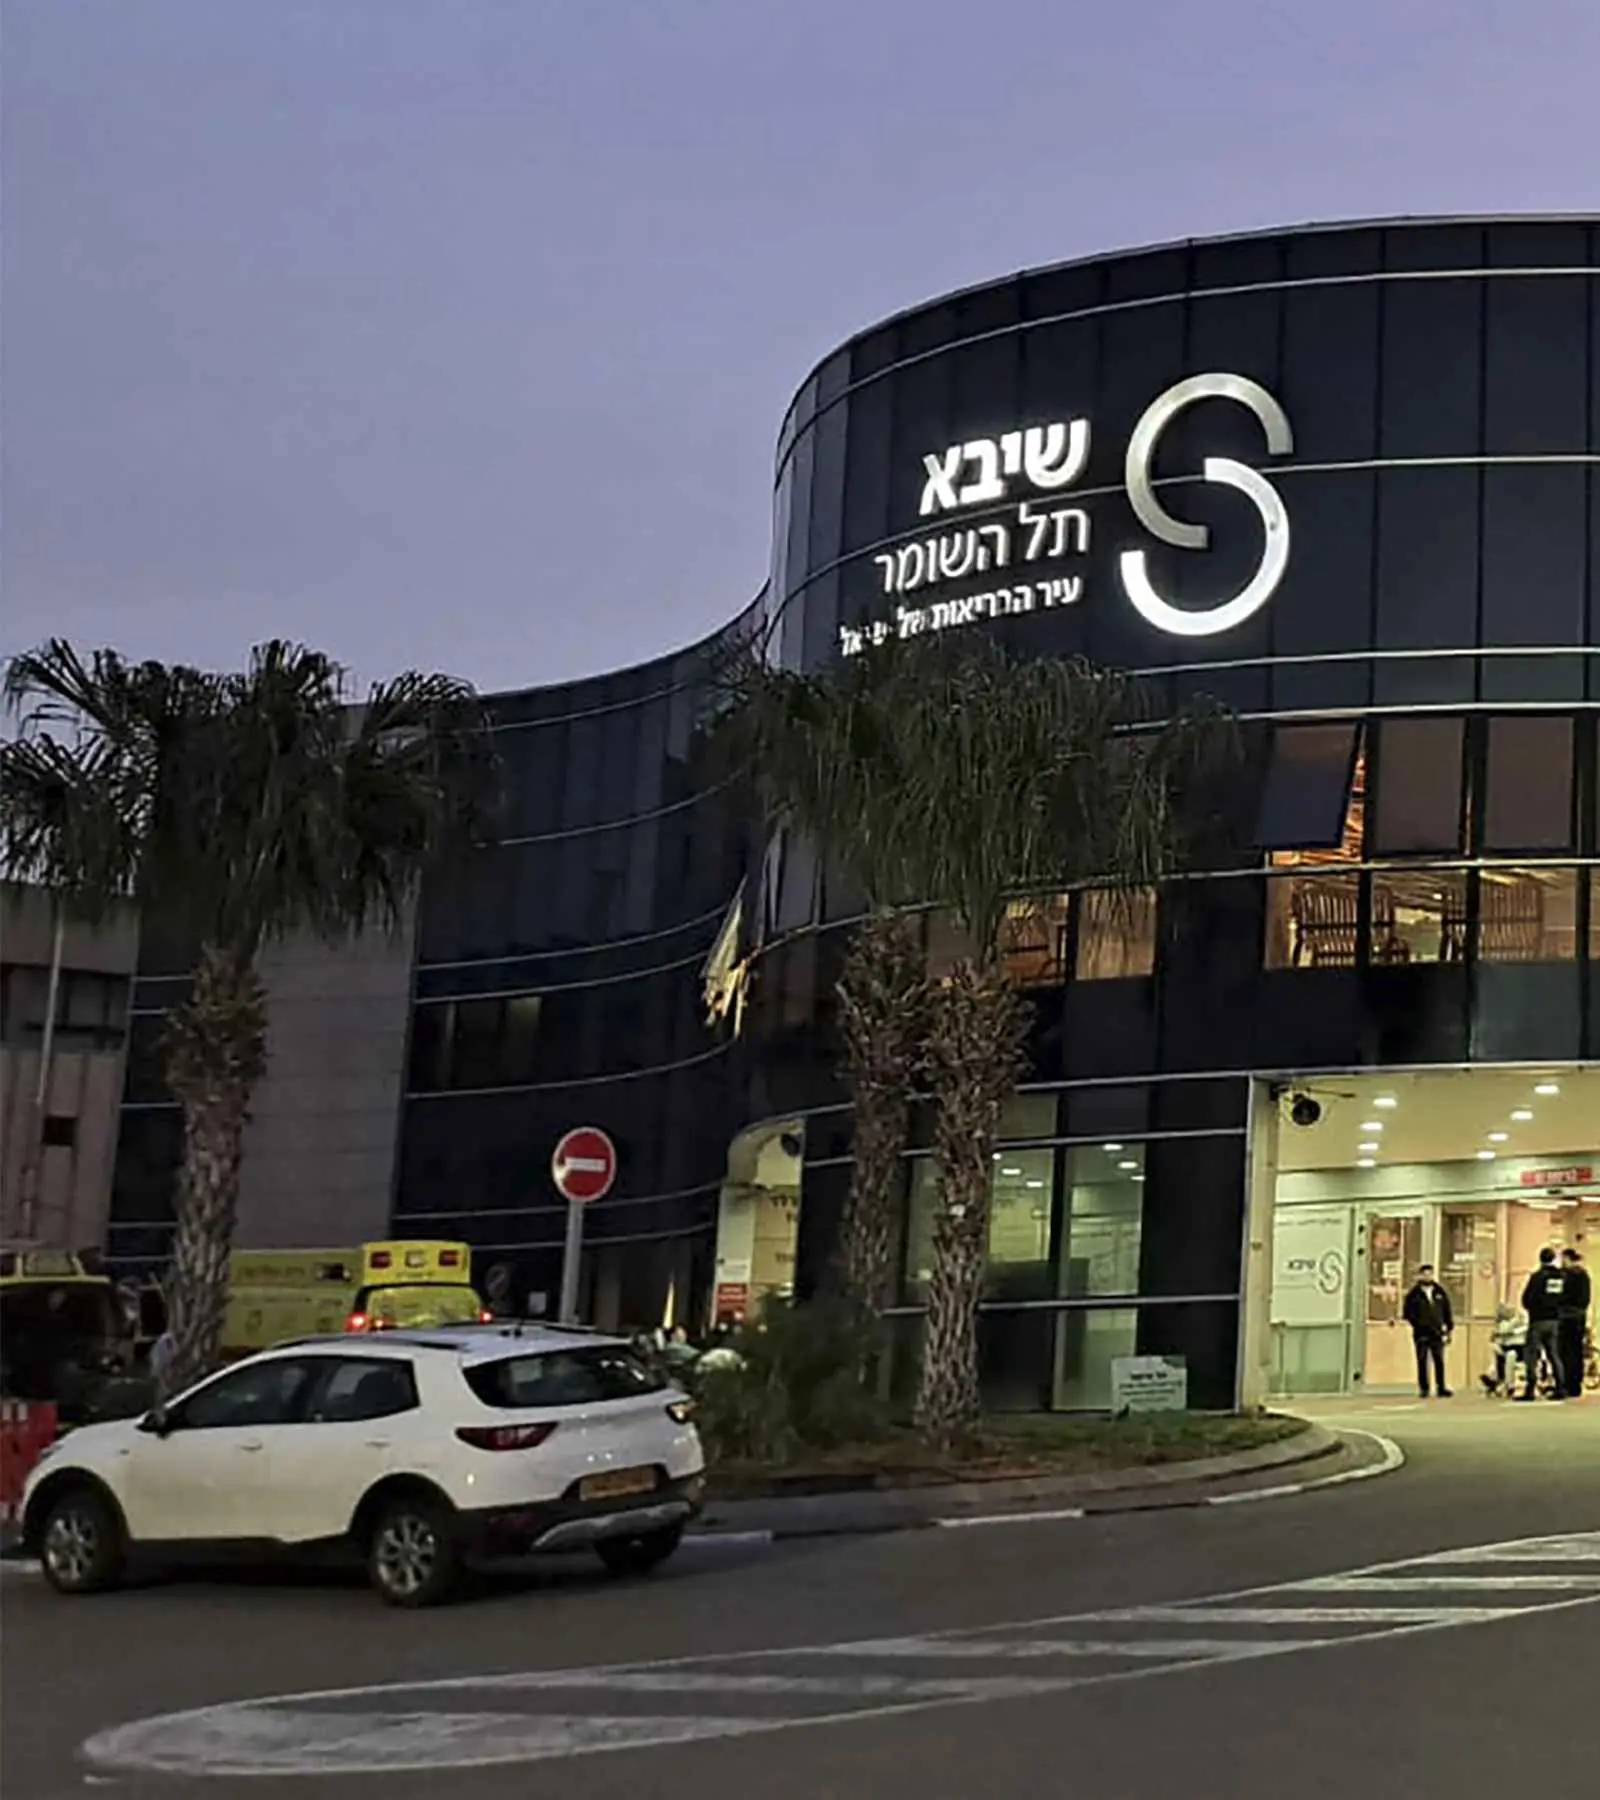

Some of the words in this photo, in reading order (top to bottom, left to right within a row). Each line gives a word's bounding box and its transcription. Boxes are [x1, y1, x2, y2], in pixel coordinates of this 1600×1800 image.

[919, 418, 1090, 515] שיבא
[874, 524, 1010, 594] השומר
[1018, 502, 1091, 561] תל
[1036, 576, 1083, 607] עיר
